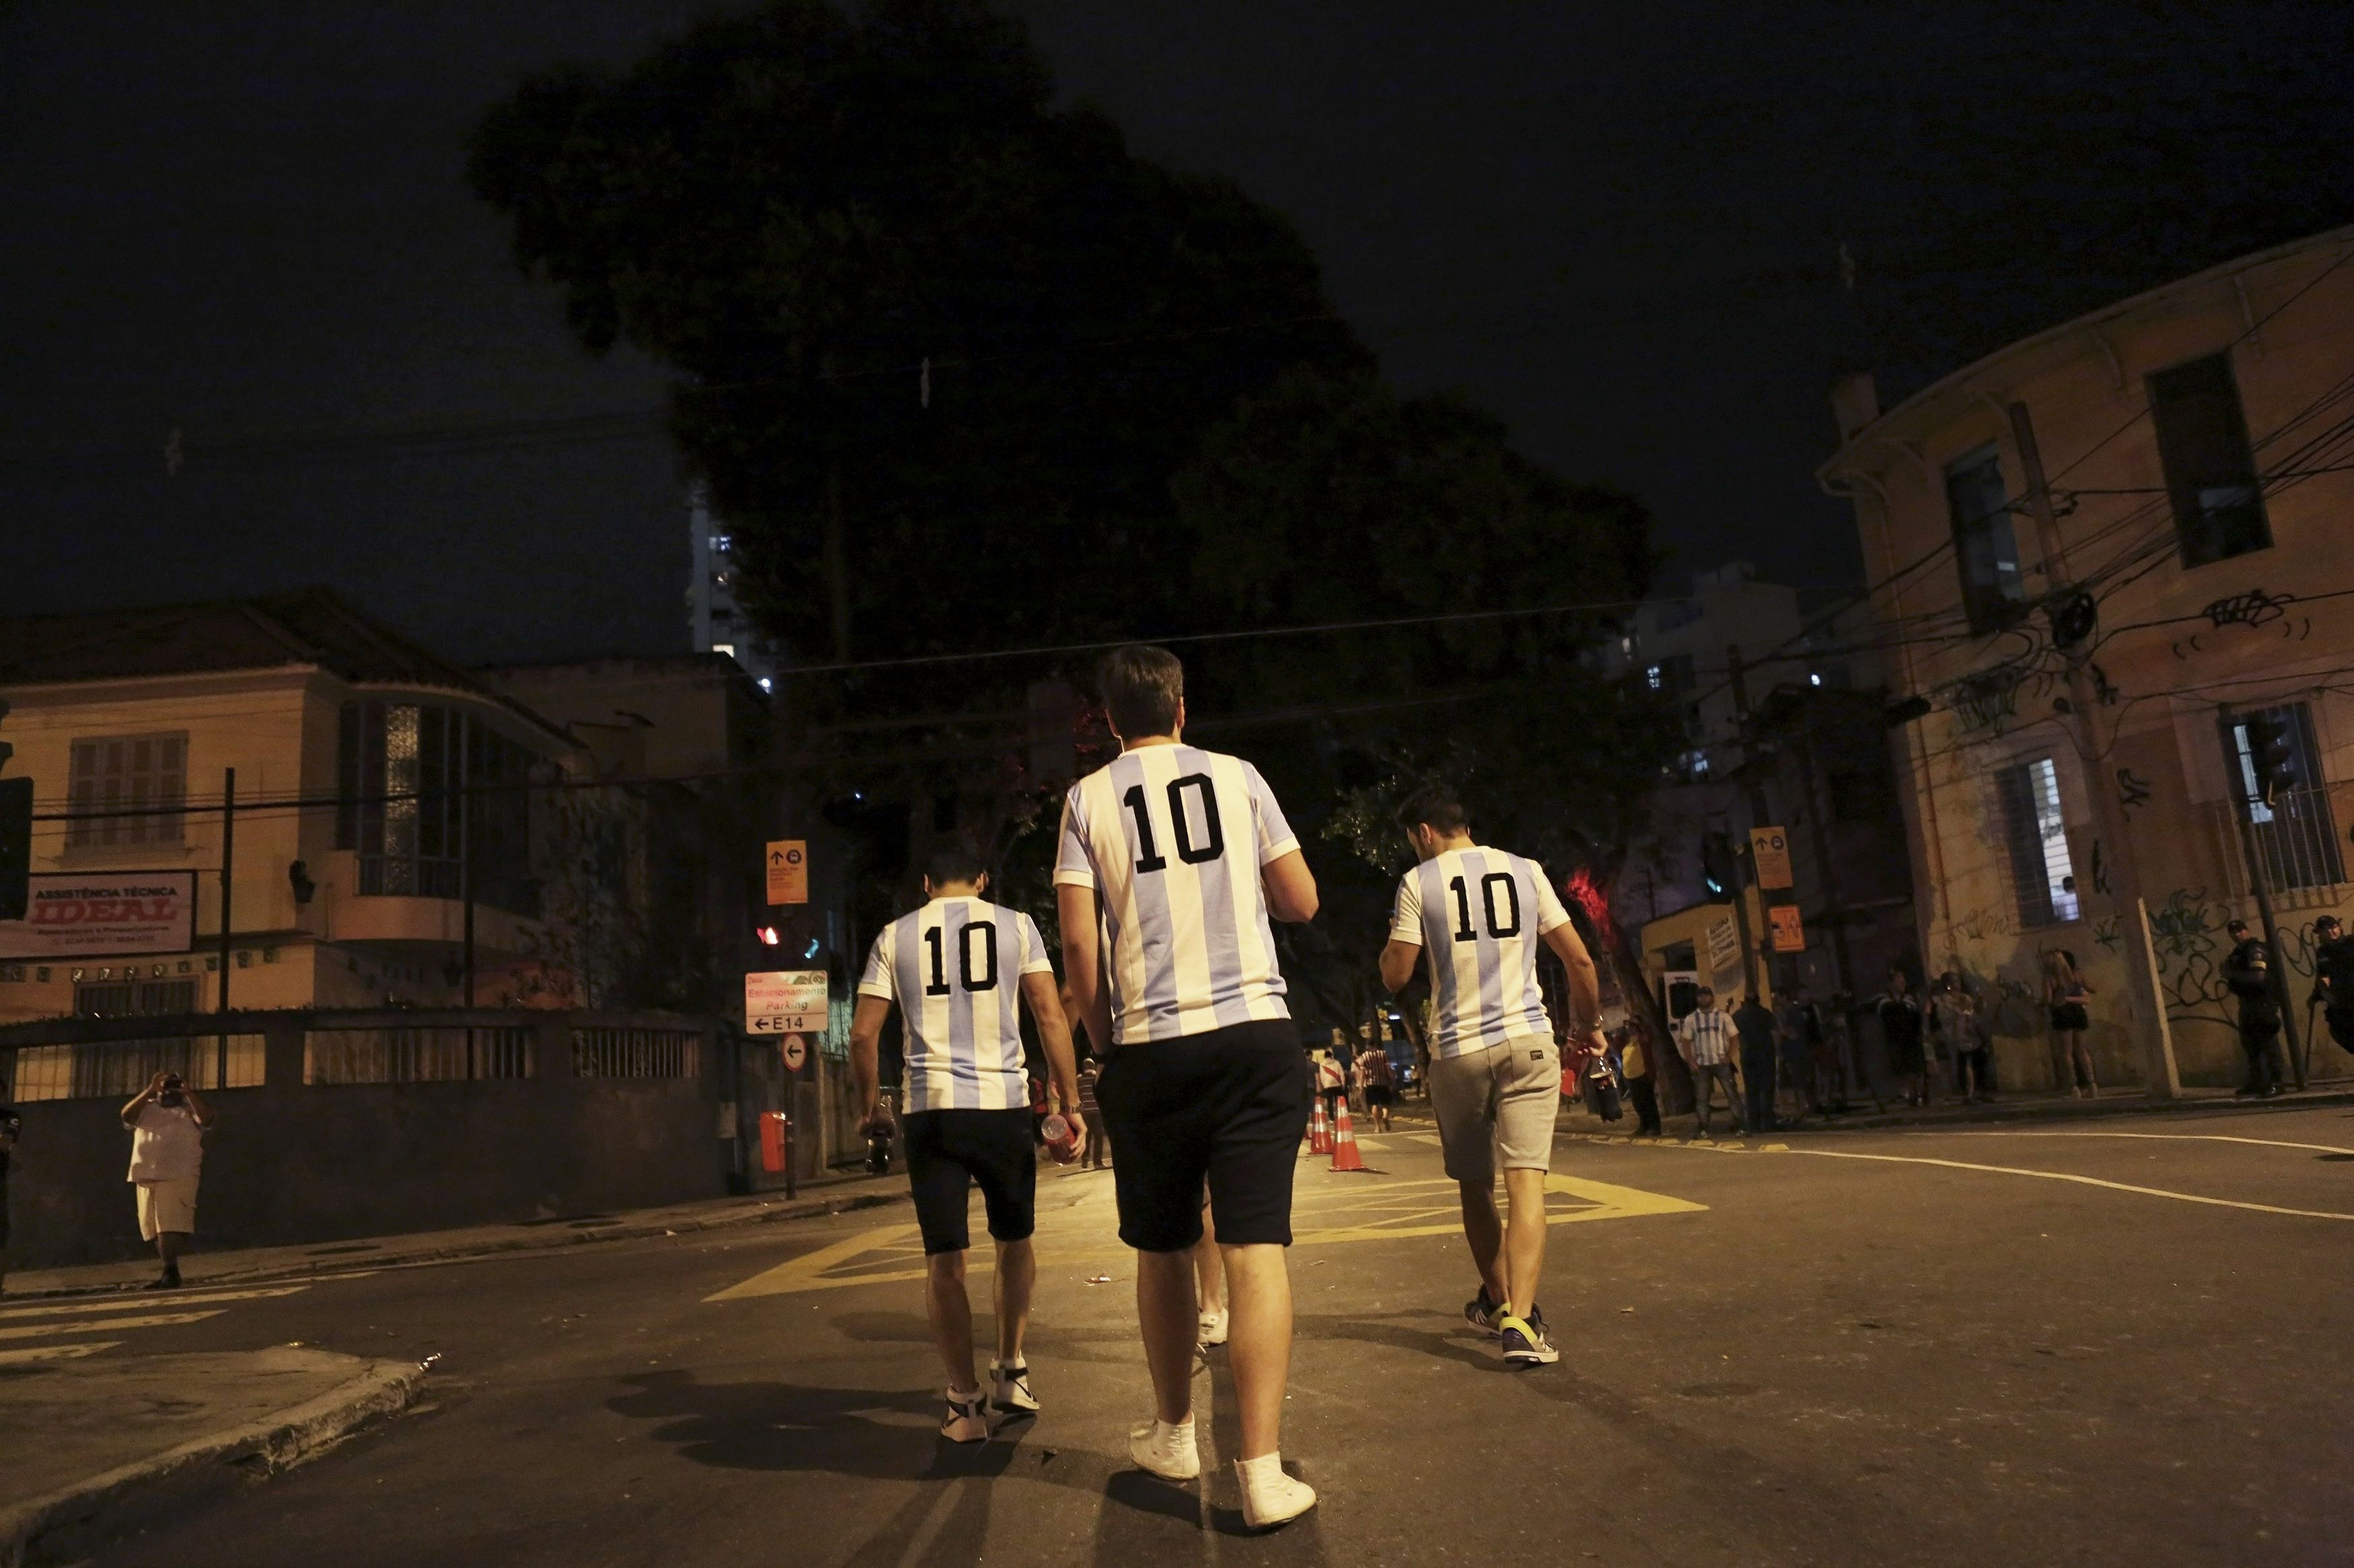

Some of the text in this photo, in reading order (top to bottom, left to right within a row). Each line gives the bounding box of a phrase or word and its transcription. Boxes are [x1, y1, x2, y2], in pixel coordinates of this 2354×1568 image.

[1124, 773, 1224, 874] 10
[36, 886, 178, 900] ASSISTÊNCIA TÉCNICA
[31, 899, 178, 924] IDEAL
[1450, 873, 1519, 942] 10
[925, 921, 997, 995] 10
[748, 987, 826, 998] Estacionamento
[766, 1002, 808, 1011] Parking
[773, 1017, 804, 1031] E14
